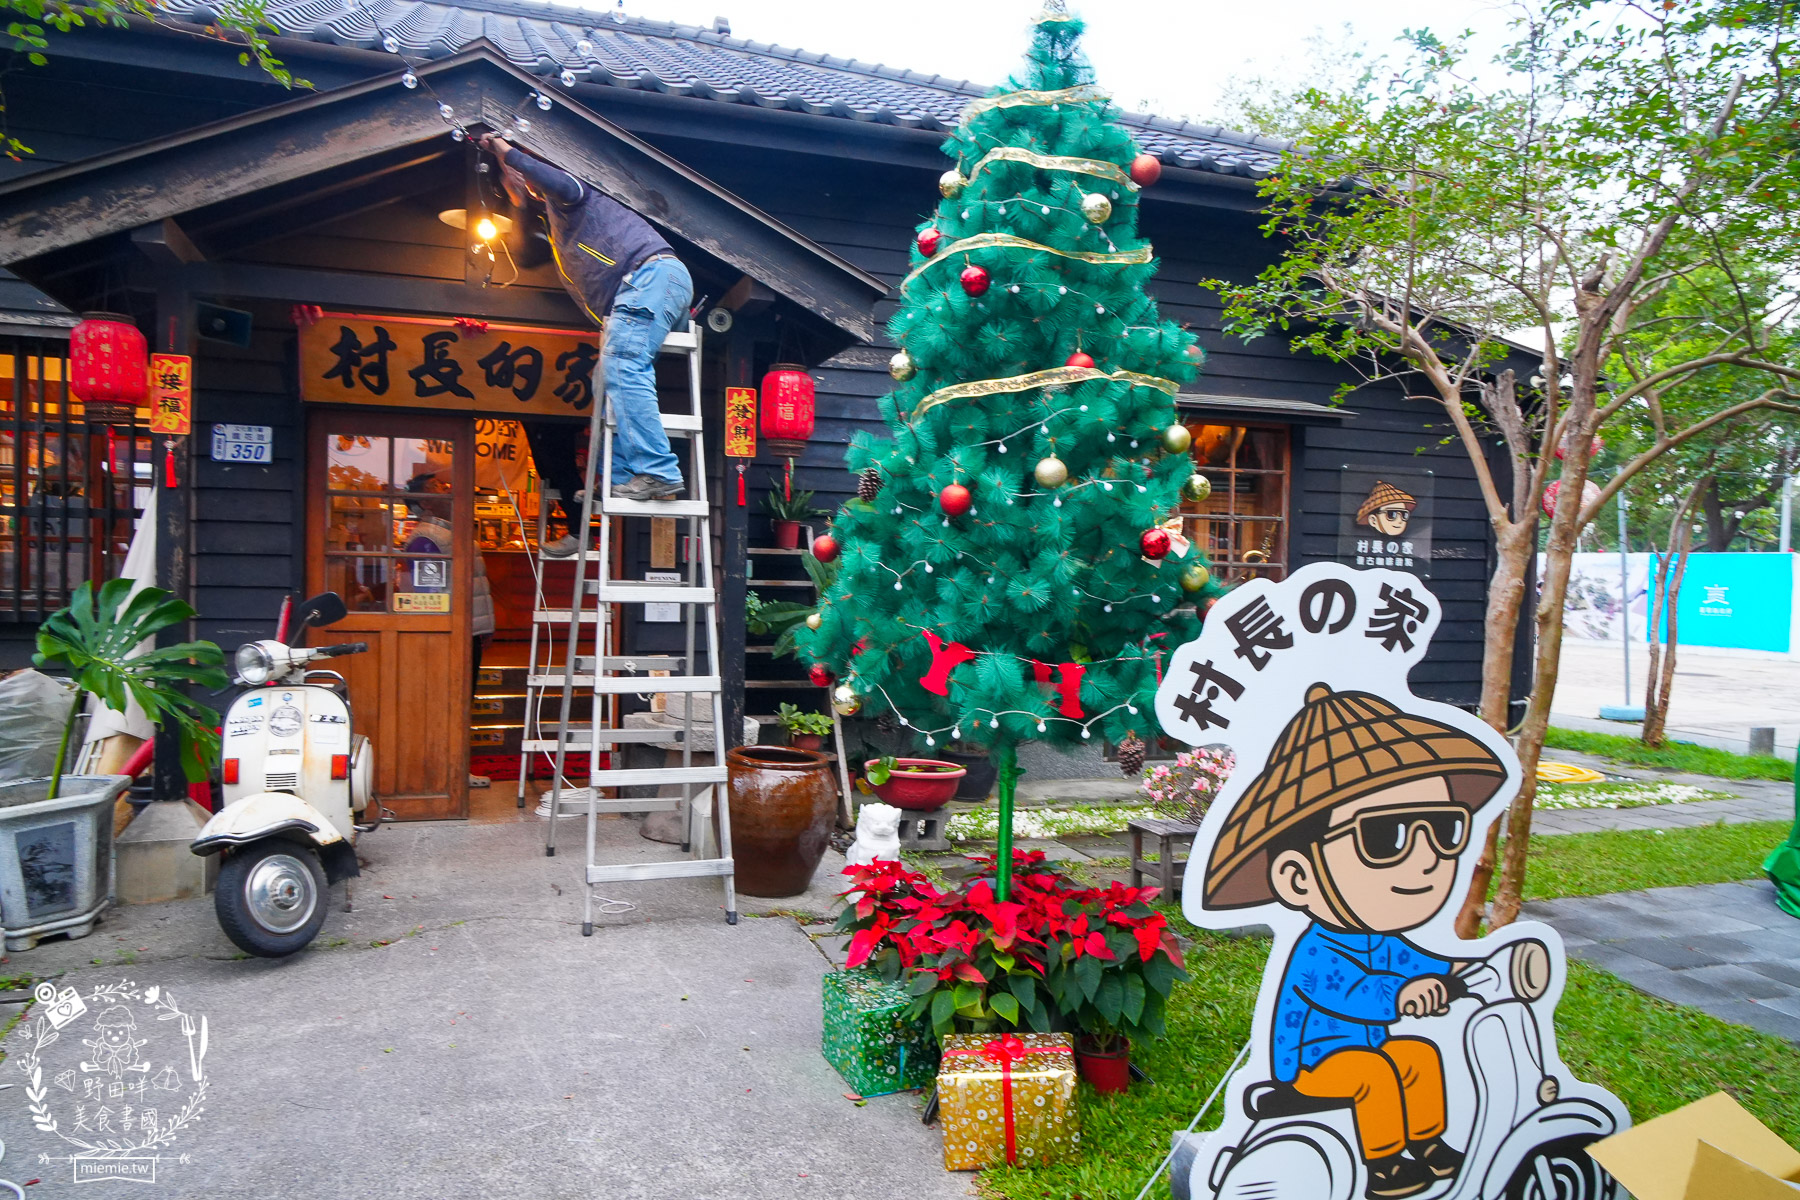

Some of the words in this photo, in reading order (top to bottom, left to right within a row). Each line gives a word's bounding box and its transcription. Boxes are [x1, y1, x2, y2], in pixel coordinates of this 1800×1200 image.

[322, 325, 599, 411] 村長的家
[231, 444, 265, 460] 350
[1356, 539, 1414, 555] 村長の家
[1173, 578, 1430, 731] 村長の家
